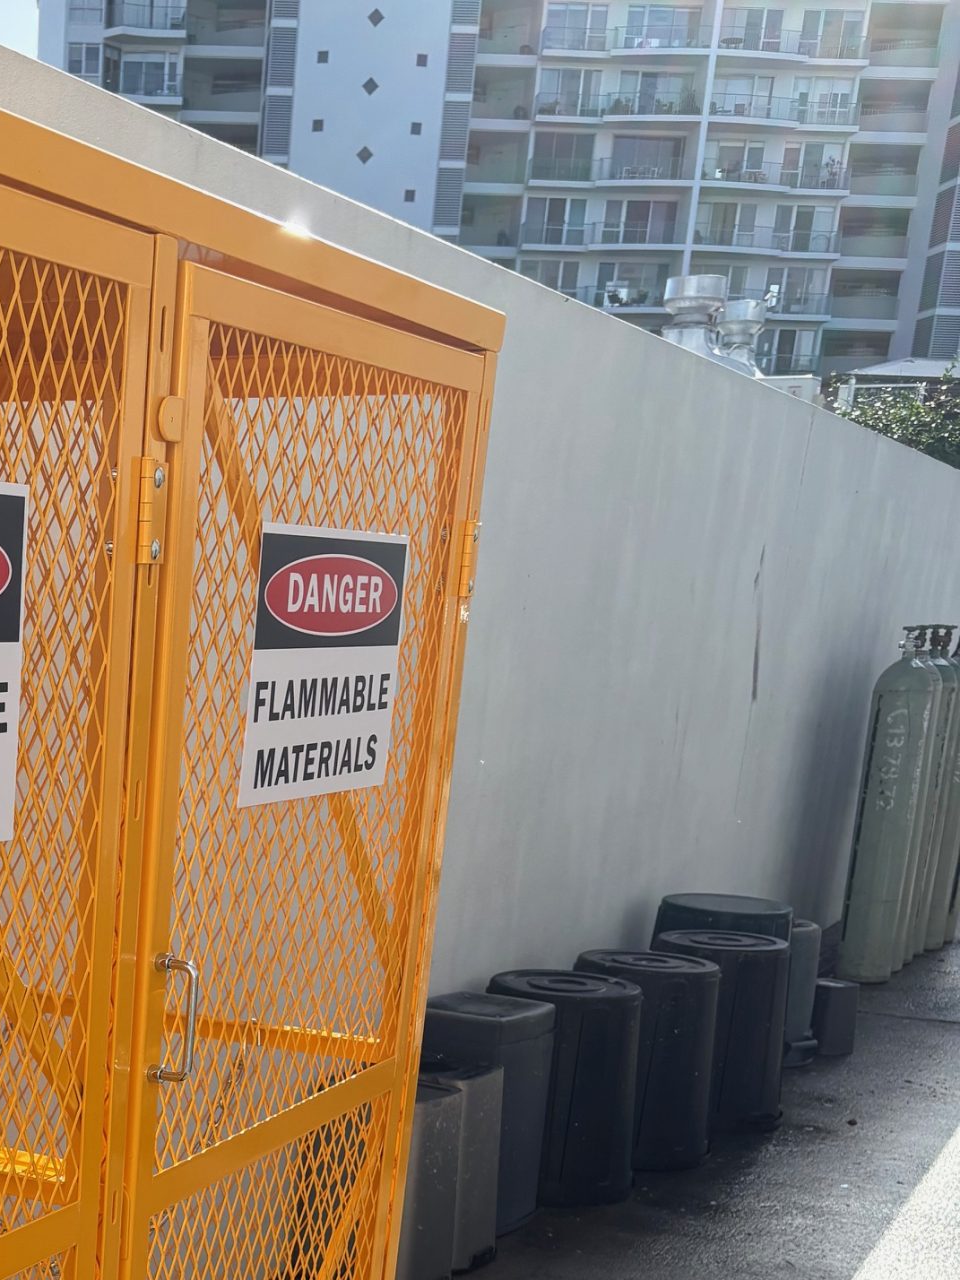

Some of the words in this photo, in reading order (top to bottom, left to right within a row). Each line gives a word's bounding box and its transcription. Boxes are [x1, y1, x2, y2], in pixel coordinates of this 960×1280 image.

[287, 572, 383, 614] DANGER
[253, 673, 391, 723] FLAMMABLE
[253, 733, 378, 789] MATERIALS
